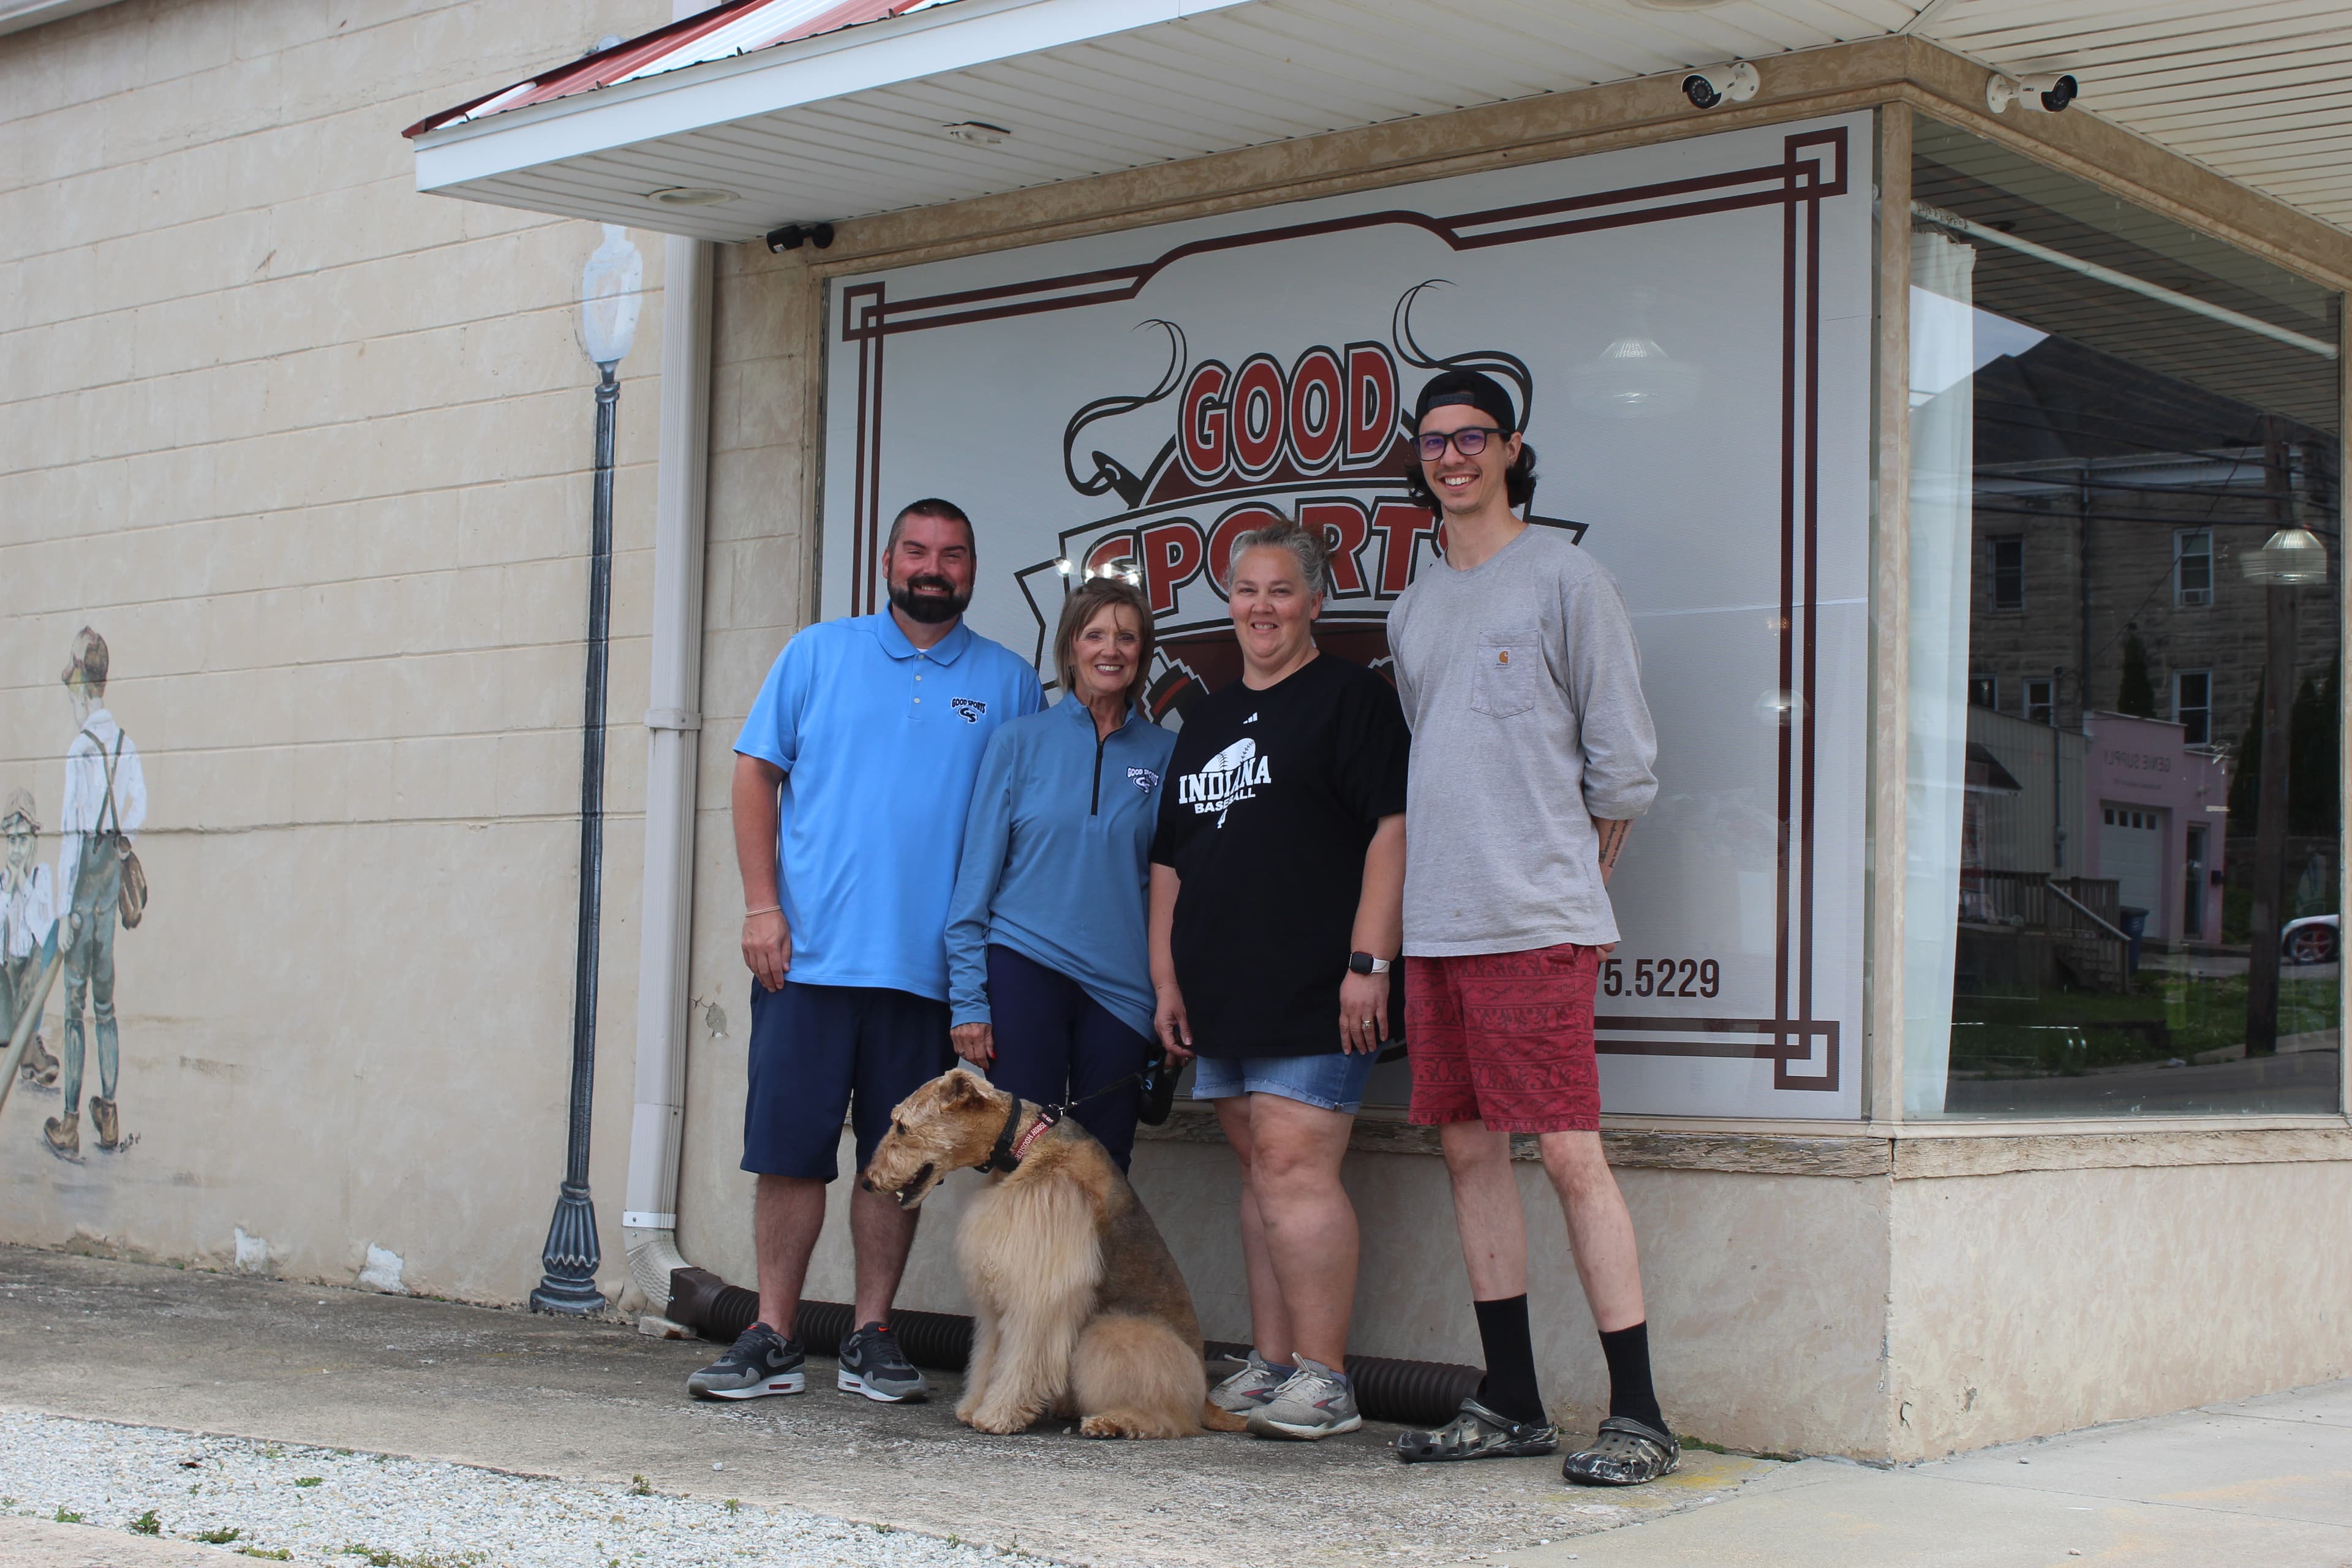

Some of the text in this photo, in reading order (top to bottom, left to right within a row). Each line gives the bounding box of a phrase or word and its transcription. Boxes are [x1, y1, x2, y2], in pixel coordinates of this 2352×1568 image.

[1179, 341, 1400, 483] GOOD
[1082, 496, 1449, 614] SPORT
[951, 698, 986, 714] GOOD SPORTS
[1127, 767, 1143, 778] GOOD
[1178, 755, 1272, 804] INDIANA
[1194, 788, 1256, 814] BASEBALL
[1597, 959, 1720, 998] 5.5229
